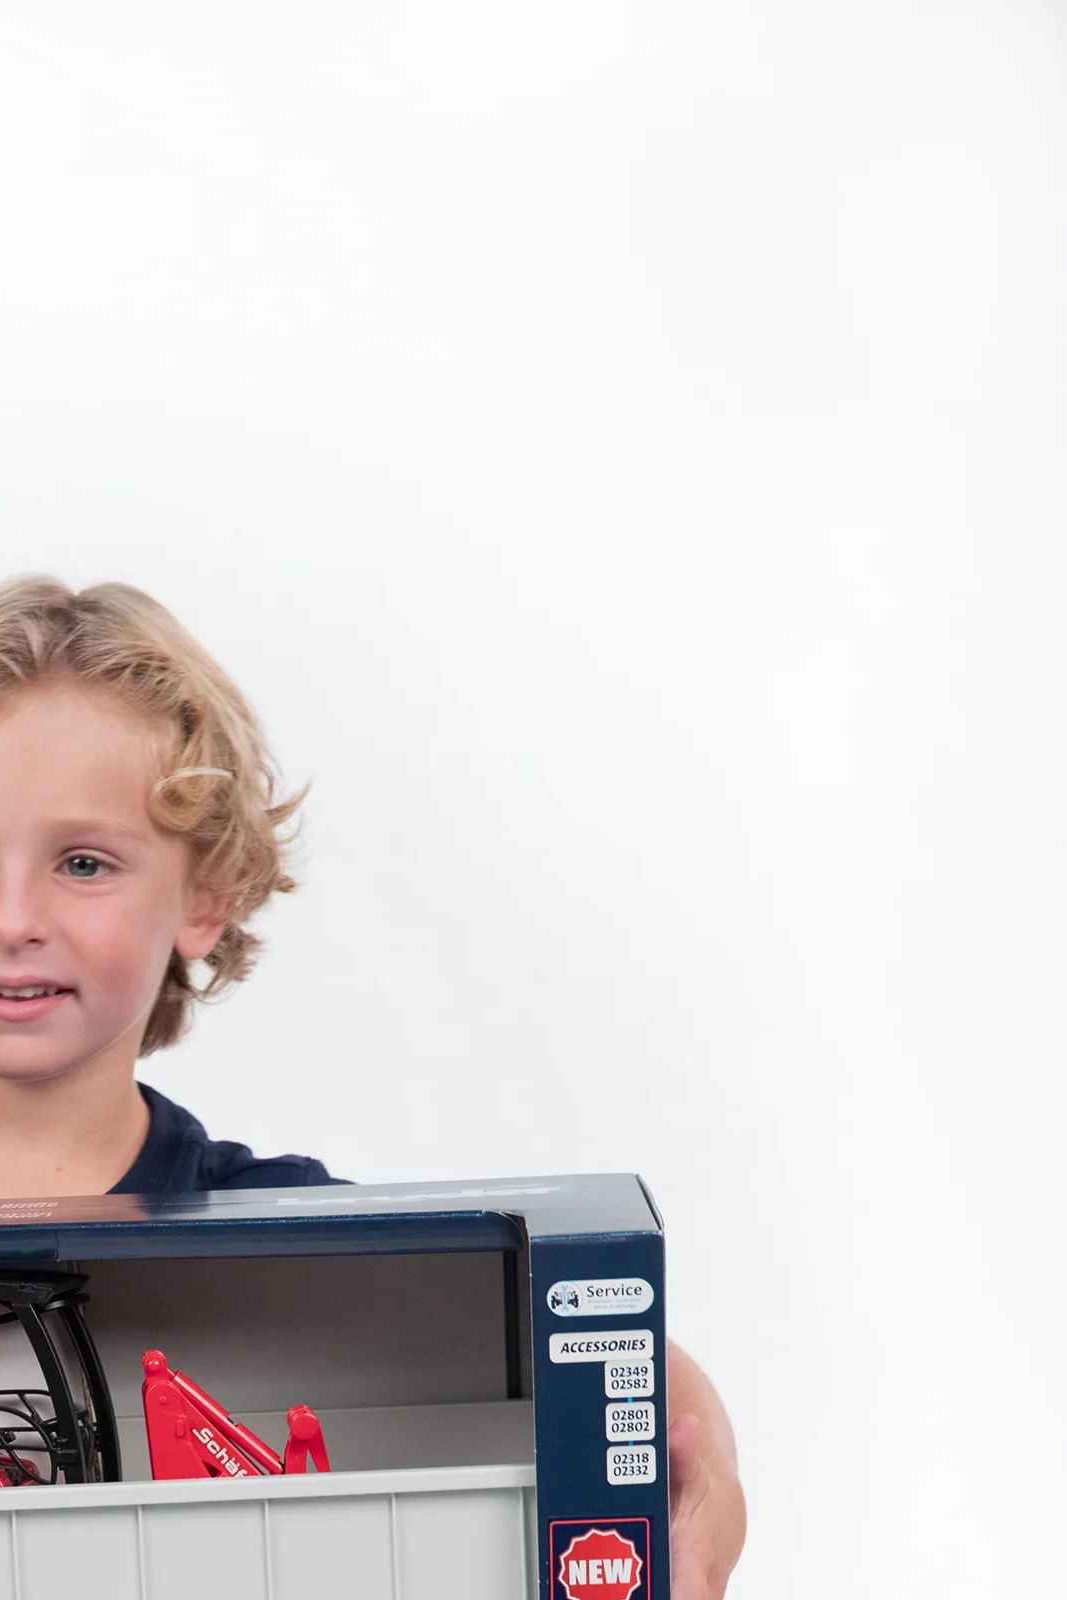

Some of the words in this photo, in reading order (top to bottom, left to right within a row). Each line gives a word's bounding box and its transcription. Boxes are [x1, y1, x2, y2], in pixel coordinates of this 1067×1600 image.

[587, 1284, 642, 1297] Service
[560, 1339, 646, 1354] ACCESSORIES
[610, 1366, 649, 1378] 02349
[611, 1378, 649, 1390] 02582
[612, 1409, 649, 1421] 02801
[611, 1421, 650, 1433] 02802
[613, 1453, 649, 1465] 02318
[613, 1465, 649, 1477] 02332
[569, 1558, 633, 1587] NEW
